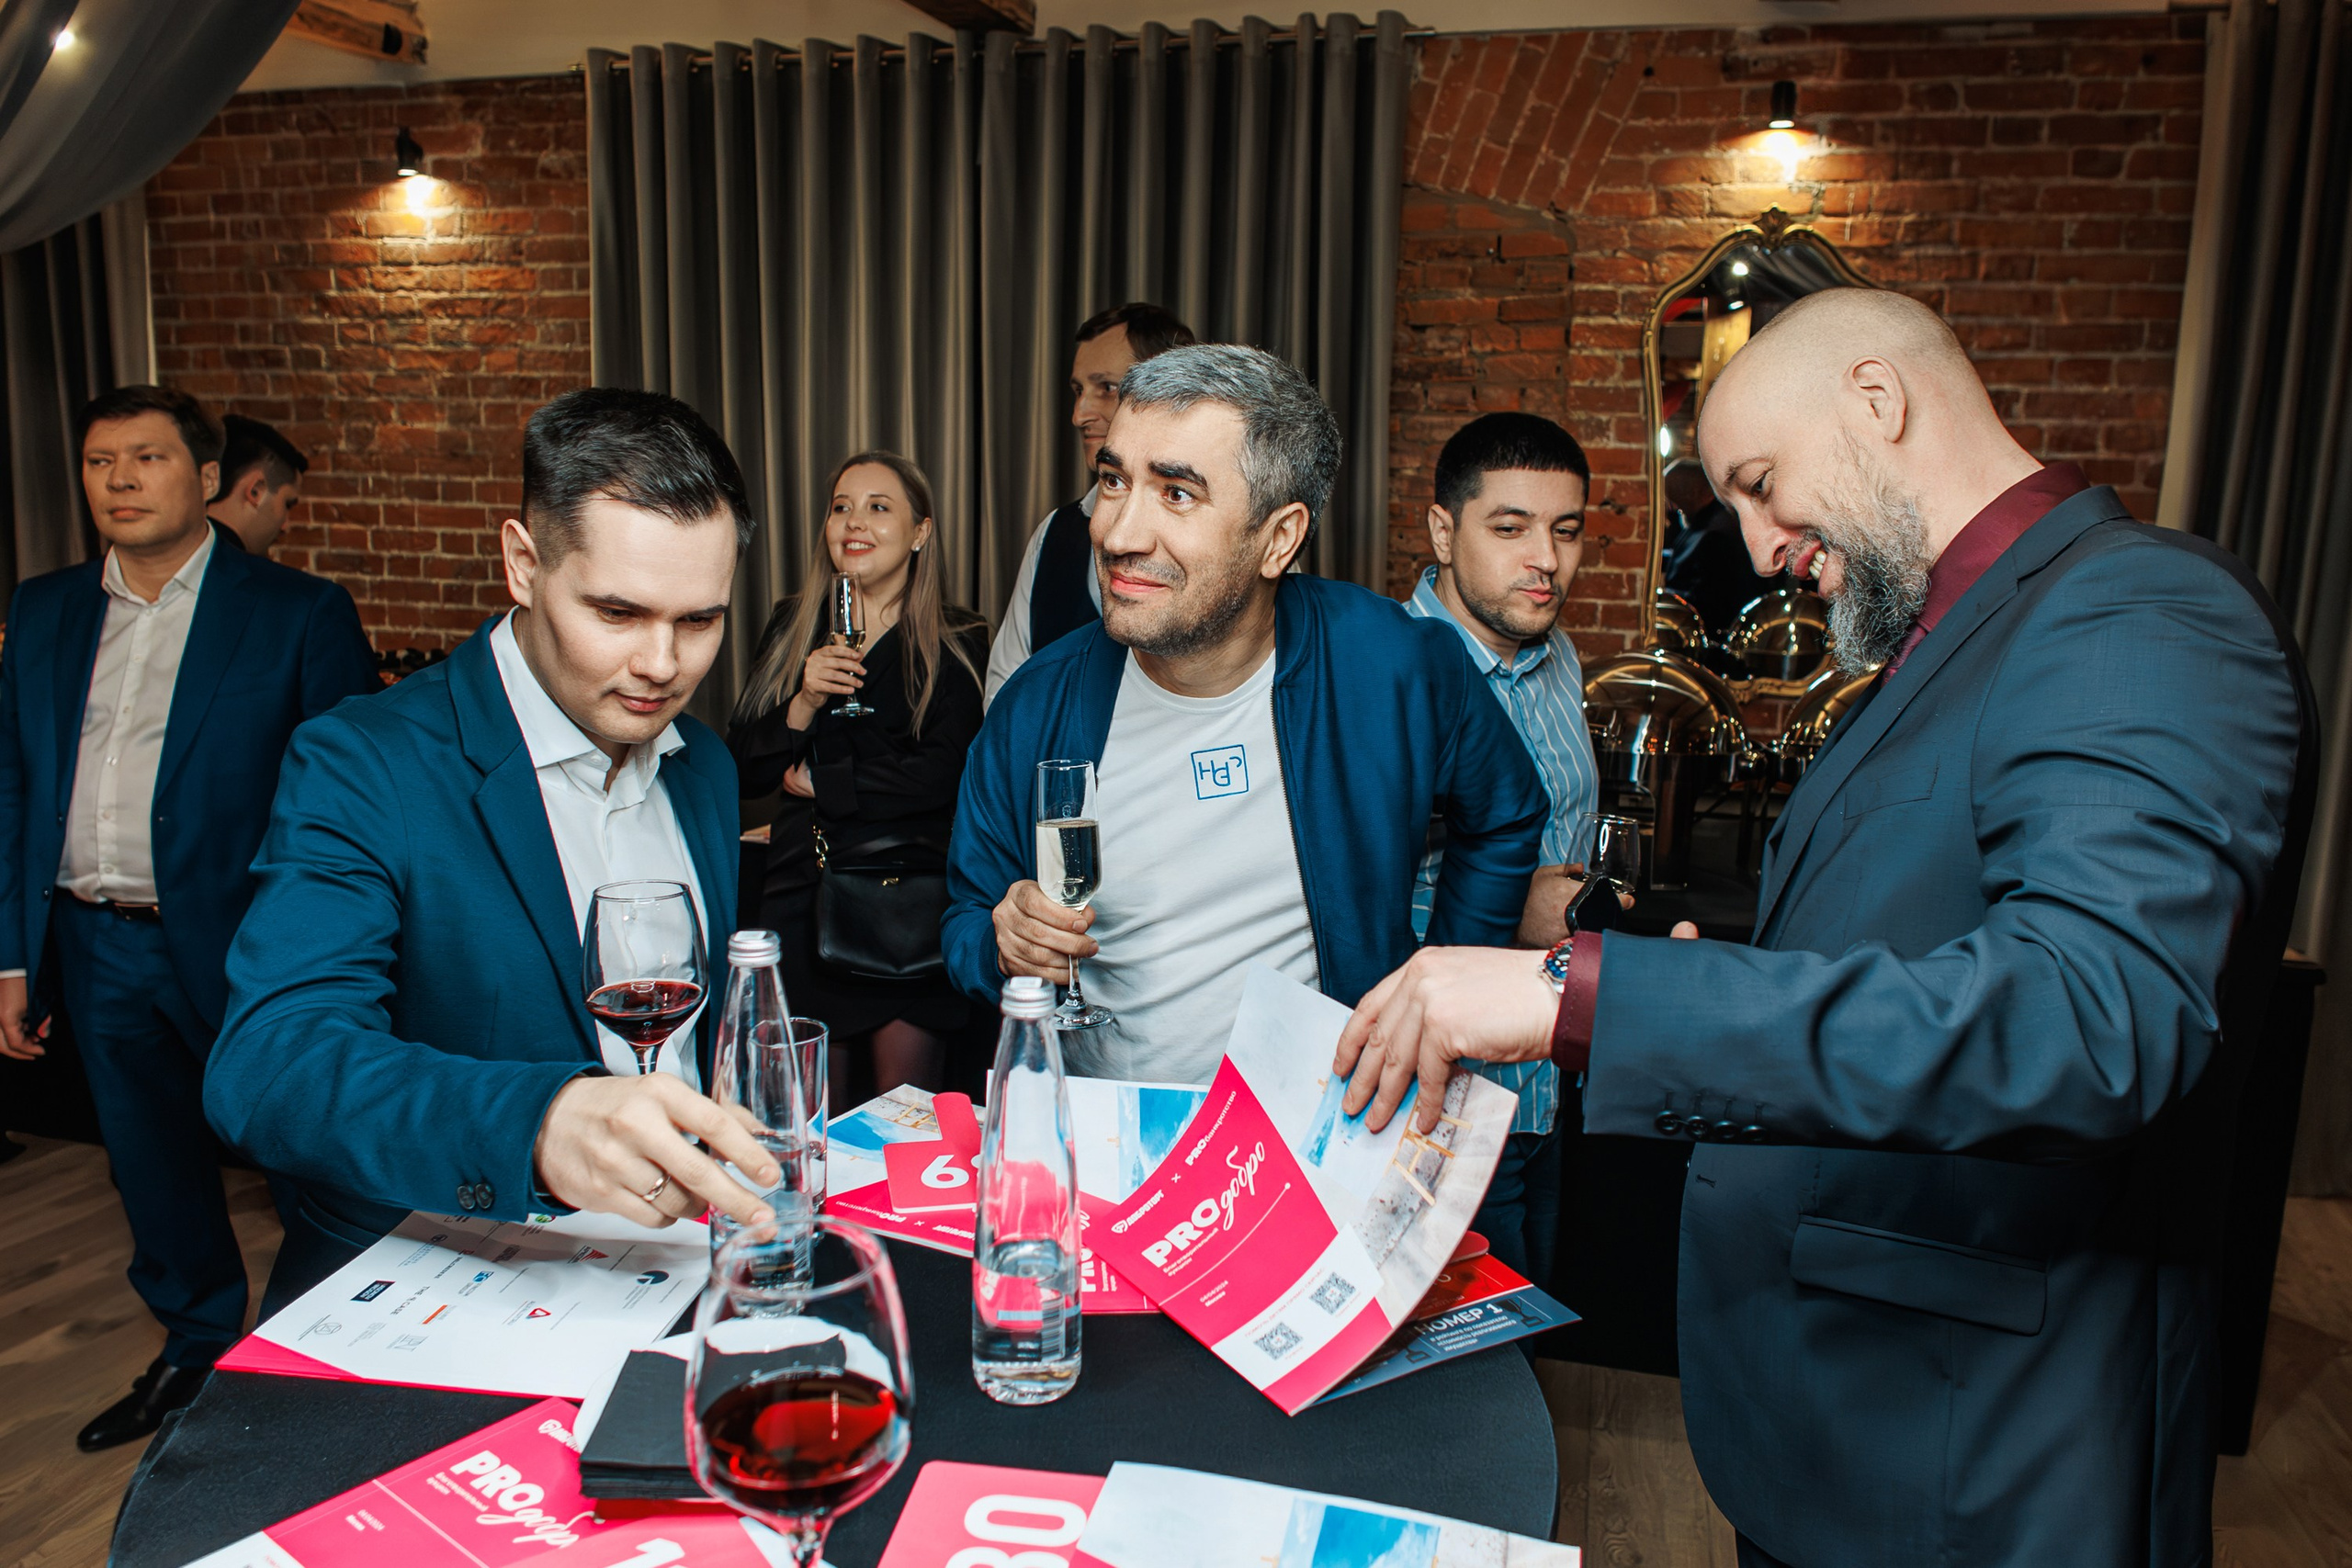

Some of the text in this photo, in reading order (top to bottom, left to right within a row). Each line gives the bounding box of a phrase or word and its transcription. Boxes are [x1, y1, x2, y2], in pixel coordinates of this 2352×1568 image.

[1414, 1308, 1484, 1335] НОМЕР
[1486, 1303, 1503, 1314] 1
[450, 1450, 606, 1549] PROдобр
